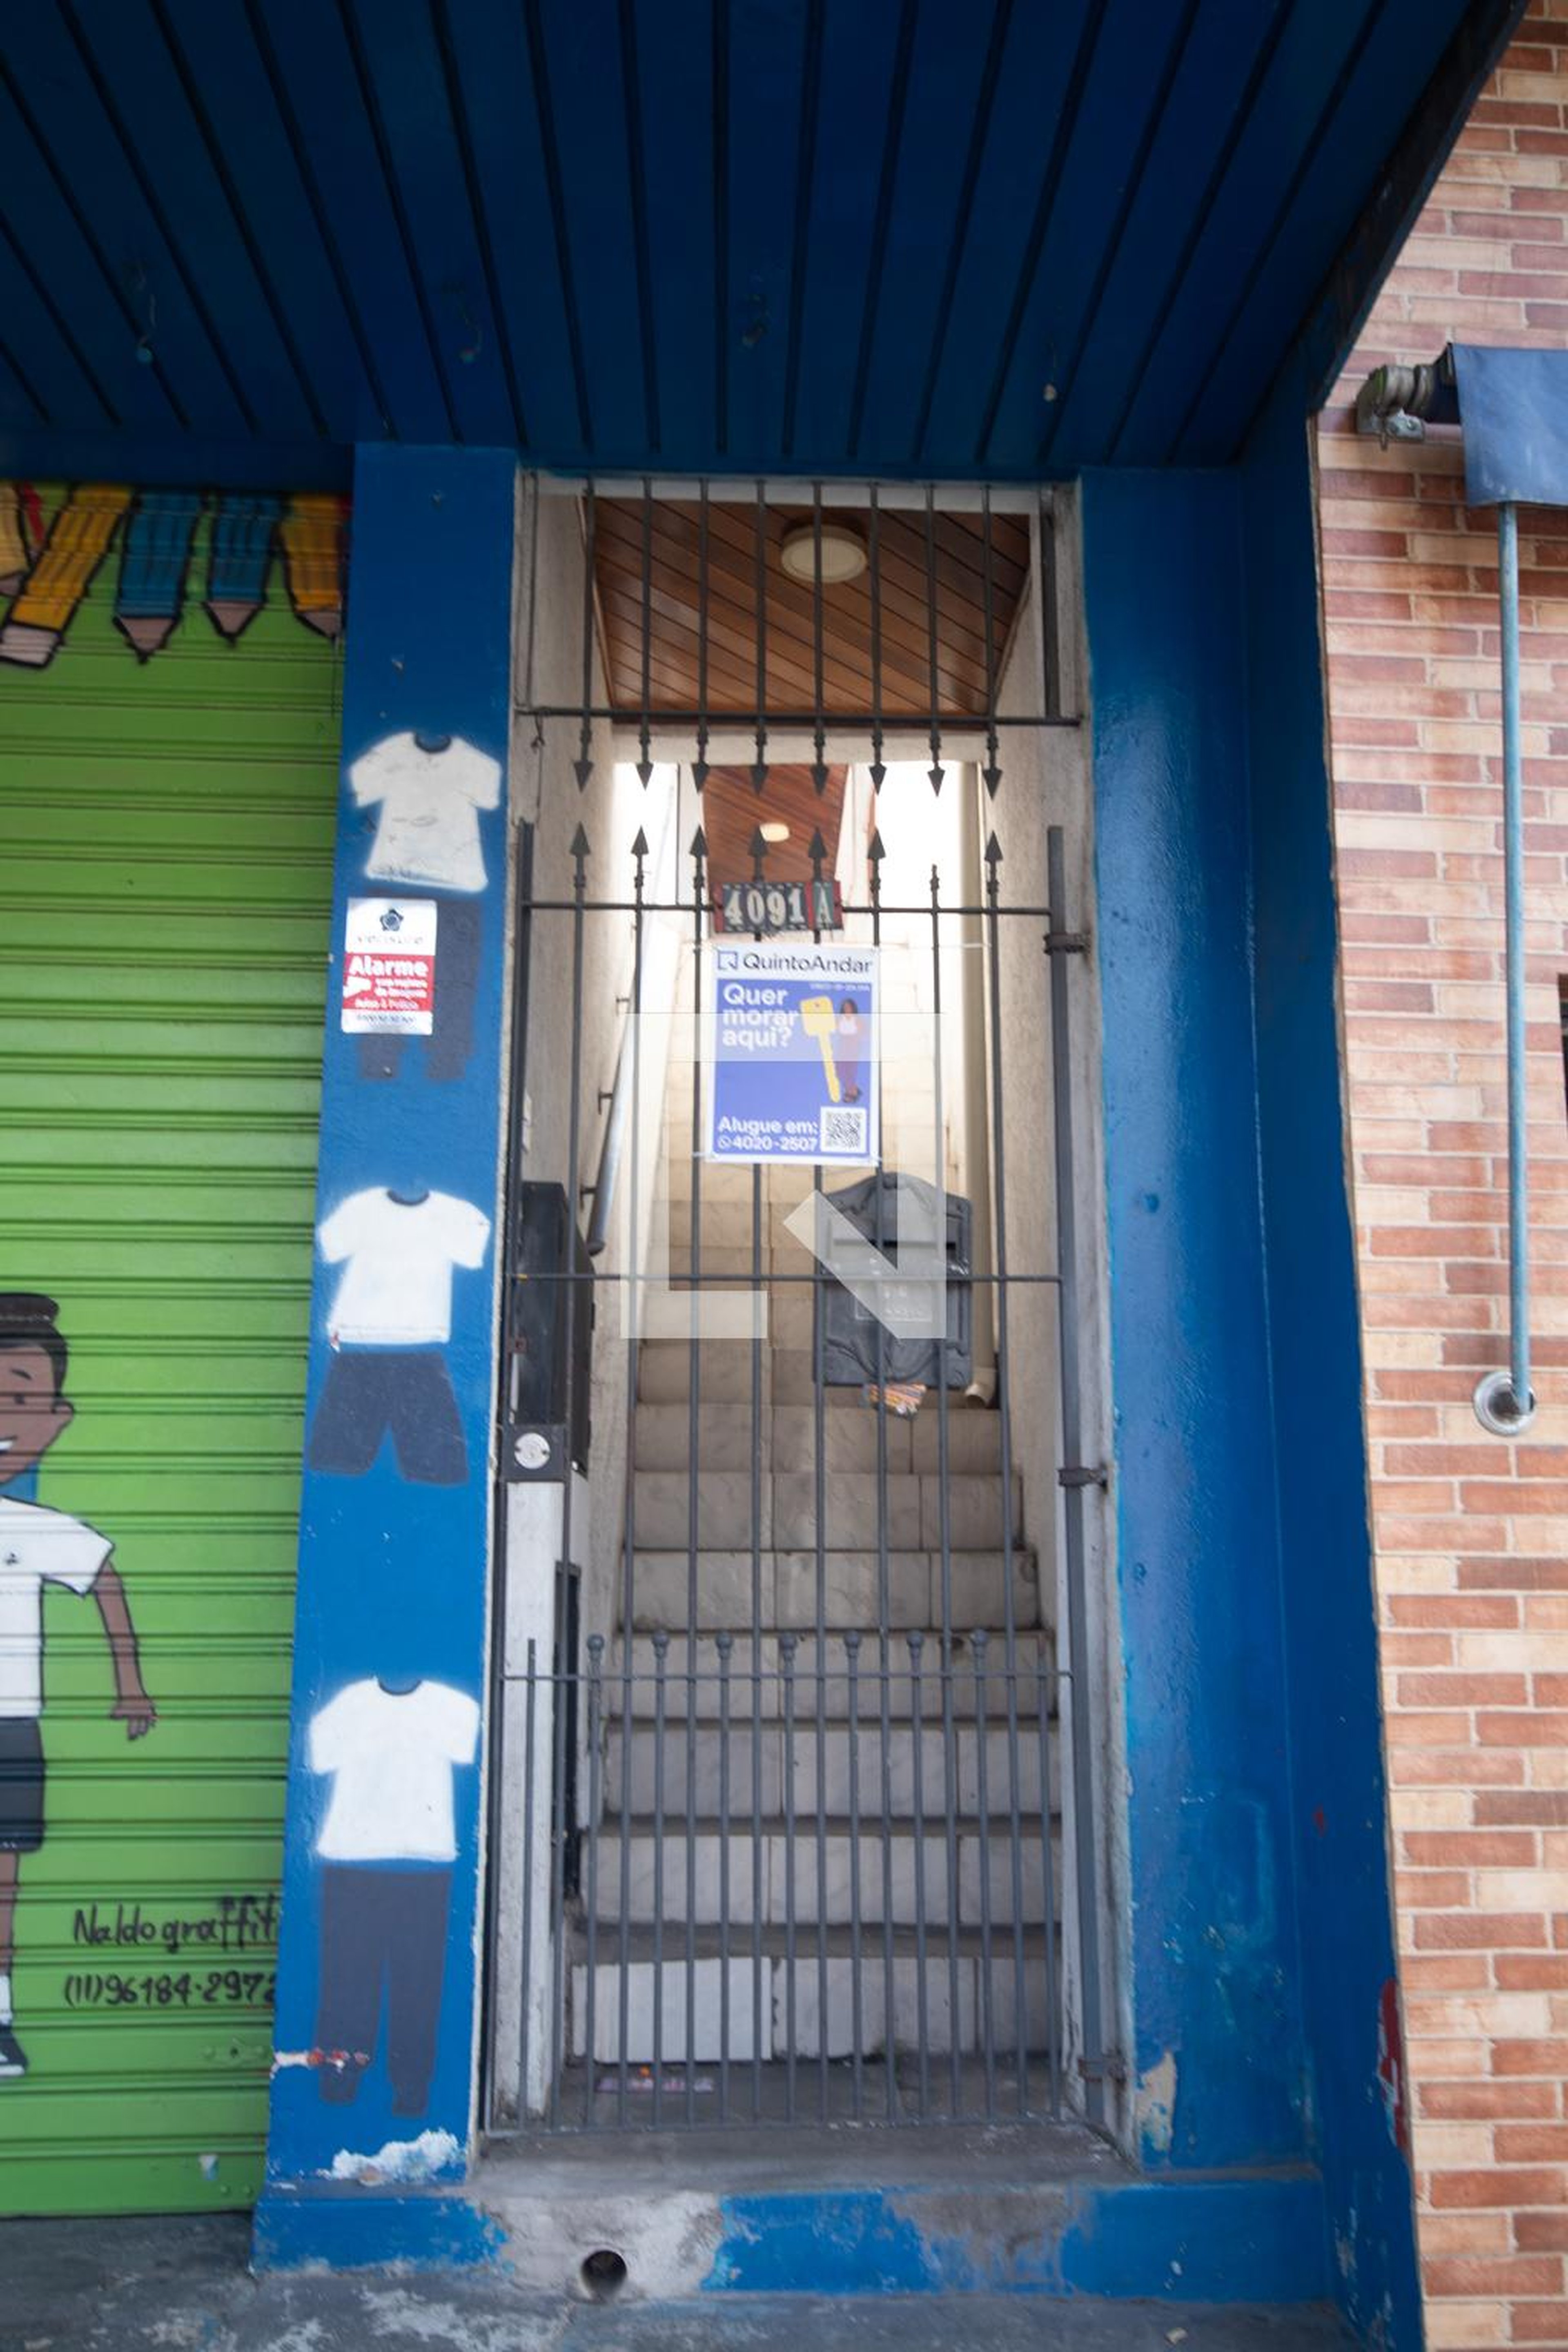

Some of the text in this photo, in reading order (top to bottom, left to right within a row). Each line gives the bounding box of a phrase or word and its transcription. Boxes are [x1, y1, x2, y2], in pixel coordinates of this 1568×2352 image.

[724, 889, 832, 927] 4091 A
[349, 955, 429, 977] Alarme
[743, 952, 873, 974] QuintoAndar
[722, 982, 788, 1006] Quer
[722, 1009, 799, 1027] morar
[722, 1026, 792, 1052] aqui?
[718, 1115, 818, 1137] Alugue em:
